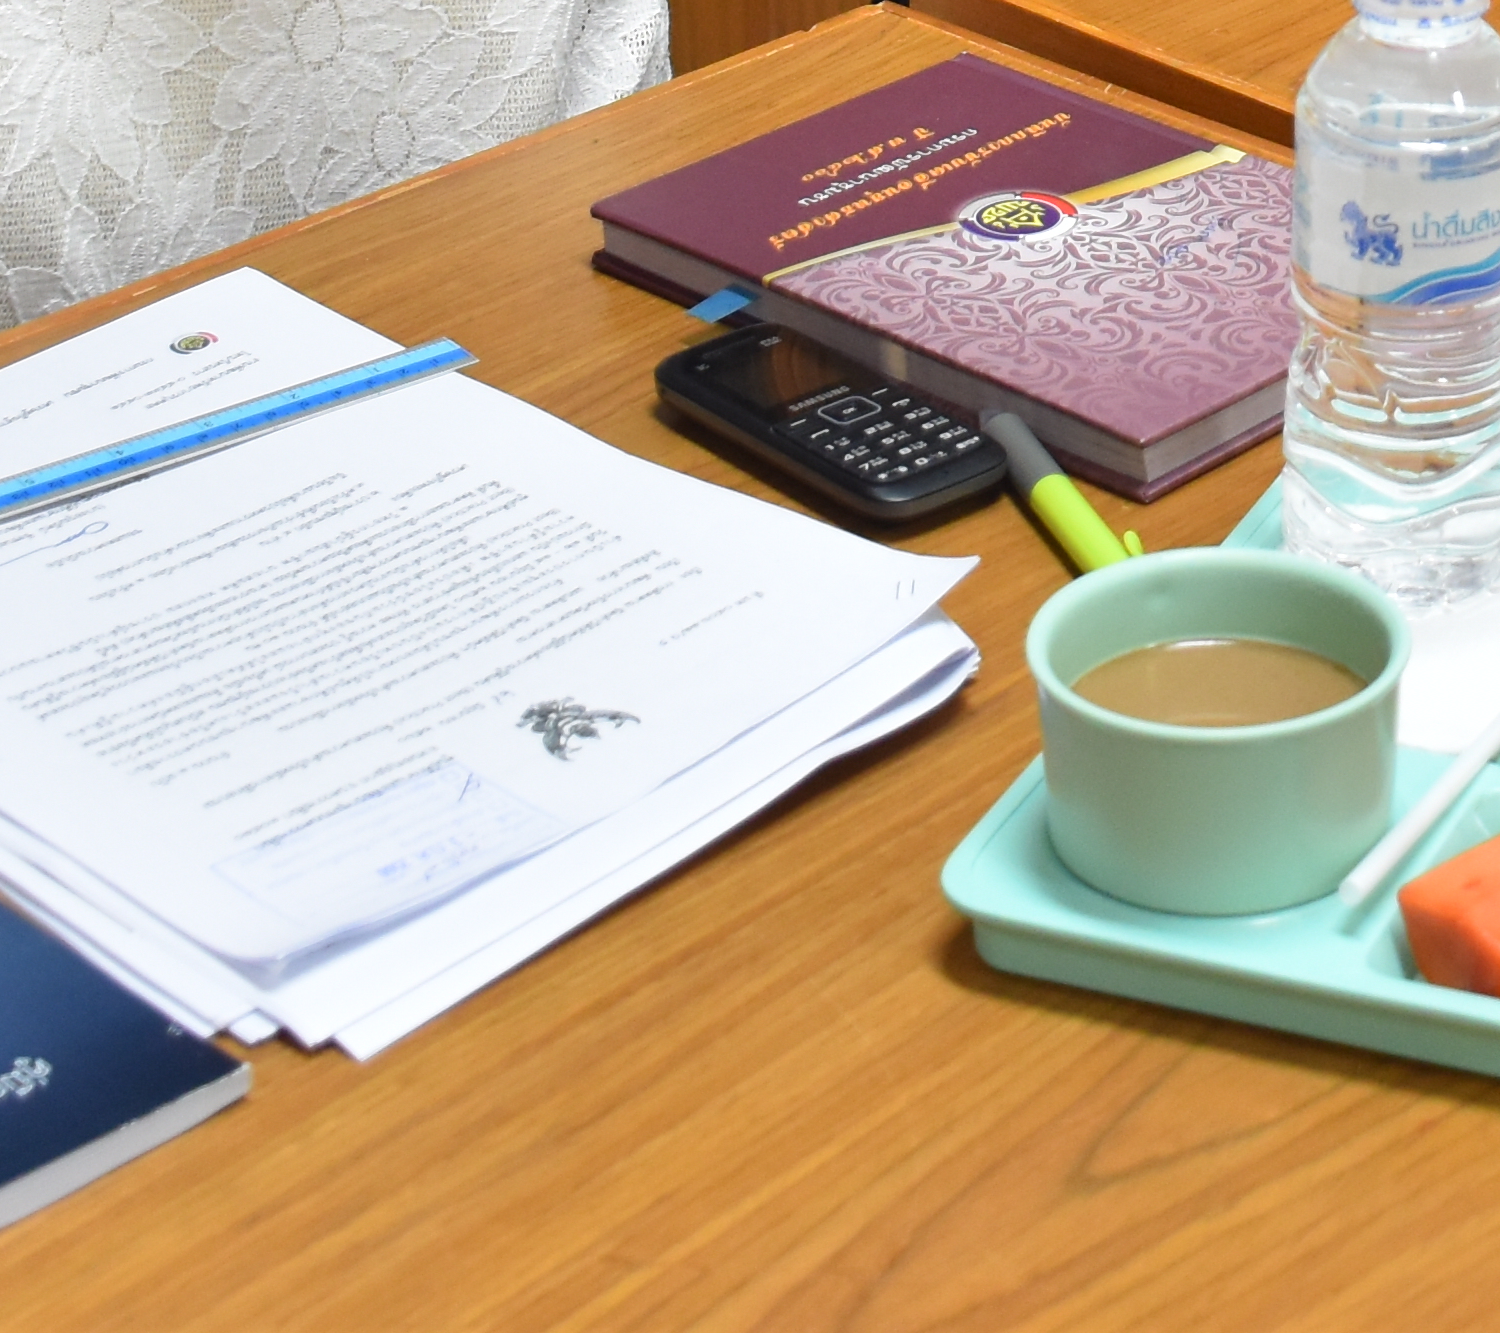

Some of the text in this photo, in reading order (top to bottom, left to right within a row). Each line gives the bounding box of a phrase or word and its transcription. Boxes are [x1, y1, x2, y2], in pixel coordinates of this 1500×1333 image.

[797, 127, 979, 208] กรมการพัฒนาชุมชน
[789, 385, 851, 412] SAMSUNG
